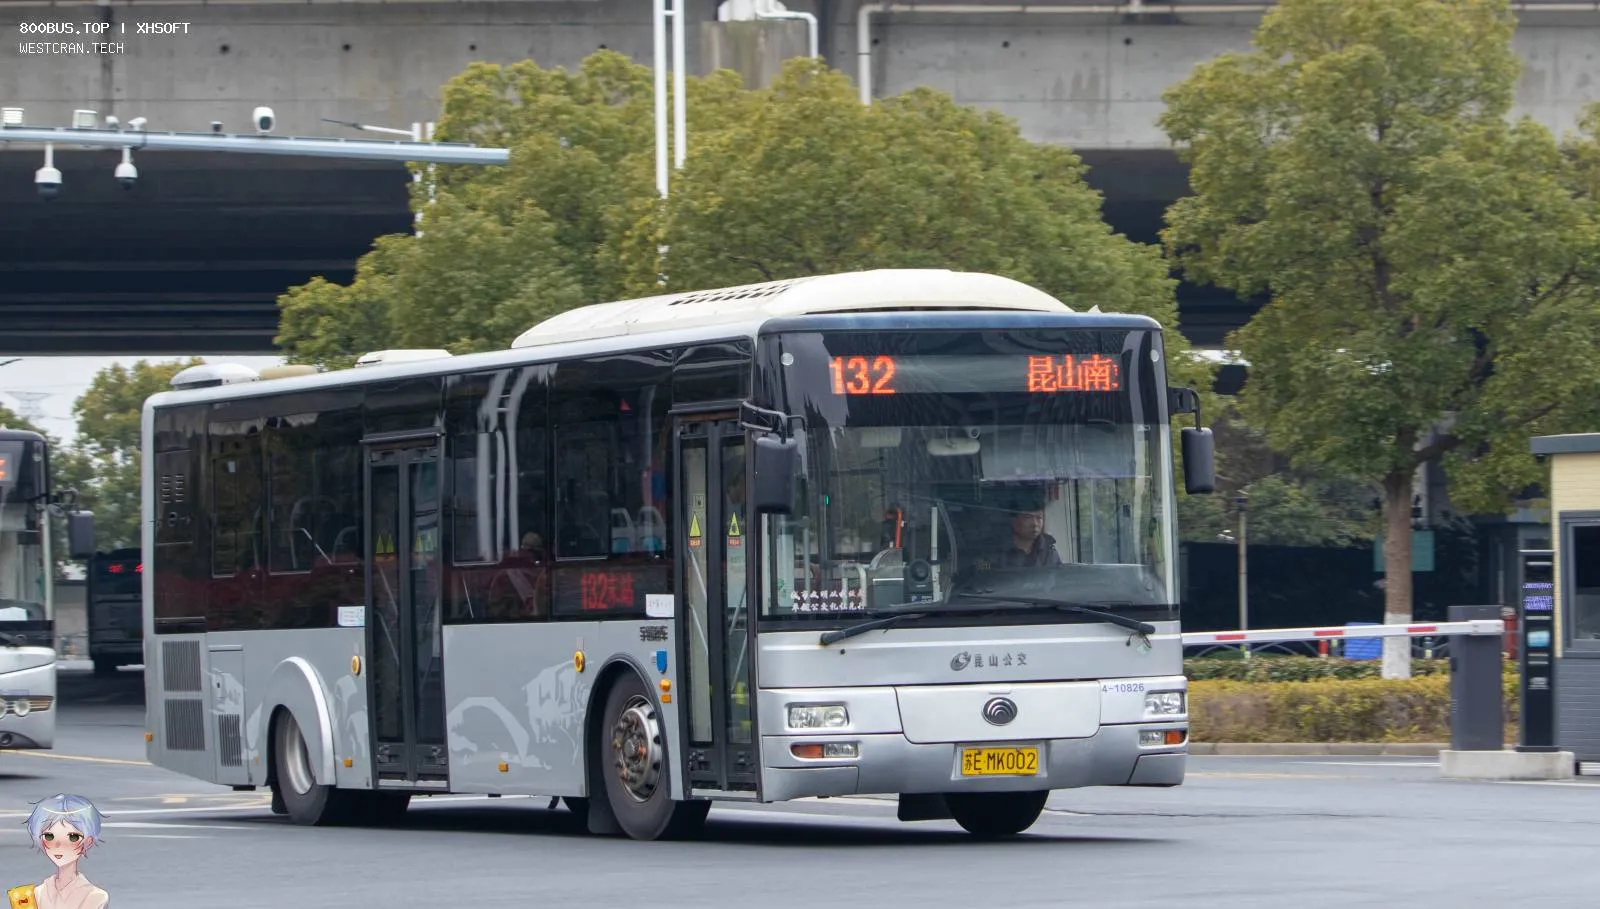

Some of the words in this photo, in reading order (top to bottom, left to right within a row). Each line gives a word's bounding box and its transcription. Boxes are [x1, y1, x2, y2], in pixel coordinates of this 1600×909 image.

[828, 355, 897, 395] 132
[1026, 354, 1120, 392] 昆山南
[973, 652, 1028, 668] 昆山公交
[1102, 683, 1145, 693] 4-10826
